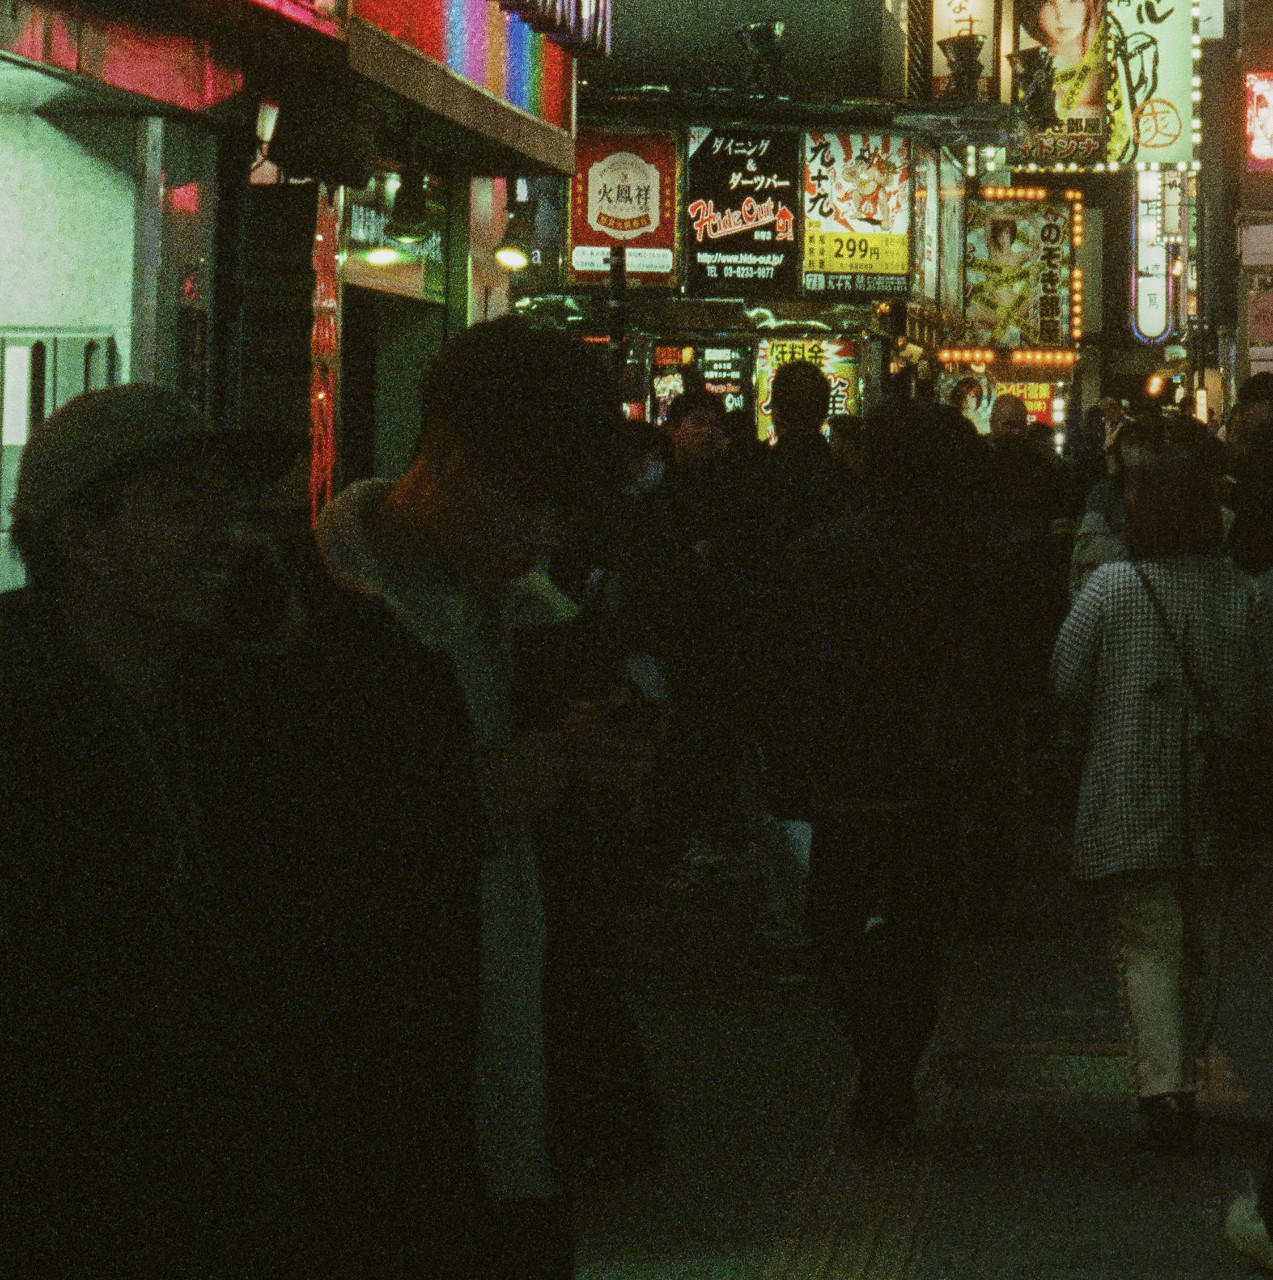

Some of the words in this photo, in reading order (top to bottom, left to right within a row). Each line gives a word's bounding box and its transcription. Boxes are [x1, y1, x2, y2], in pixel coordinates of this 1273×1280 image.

[807, 140, 837, 219] 九十九
[706, 265, 718, 278] TEL
